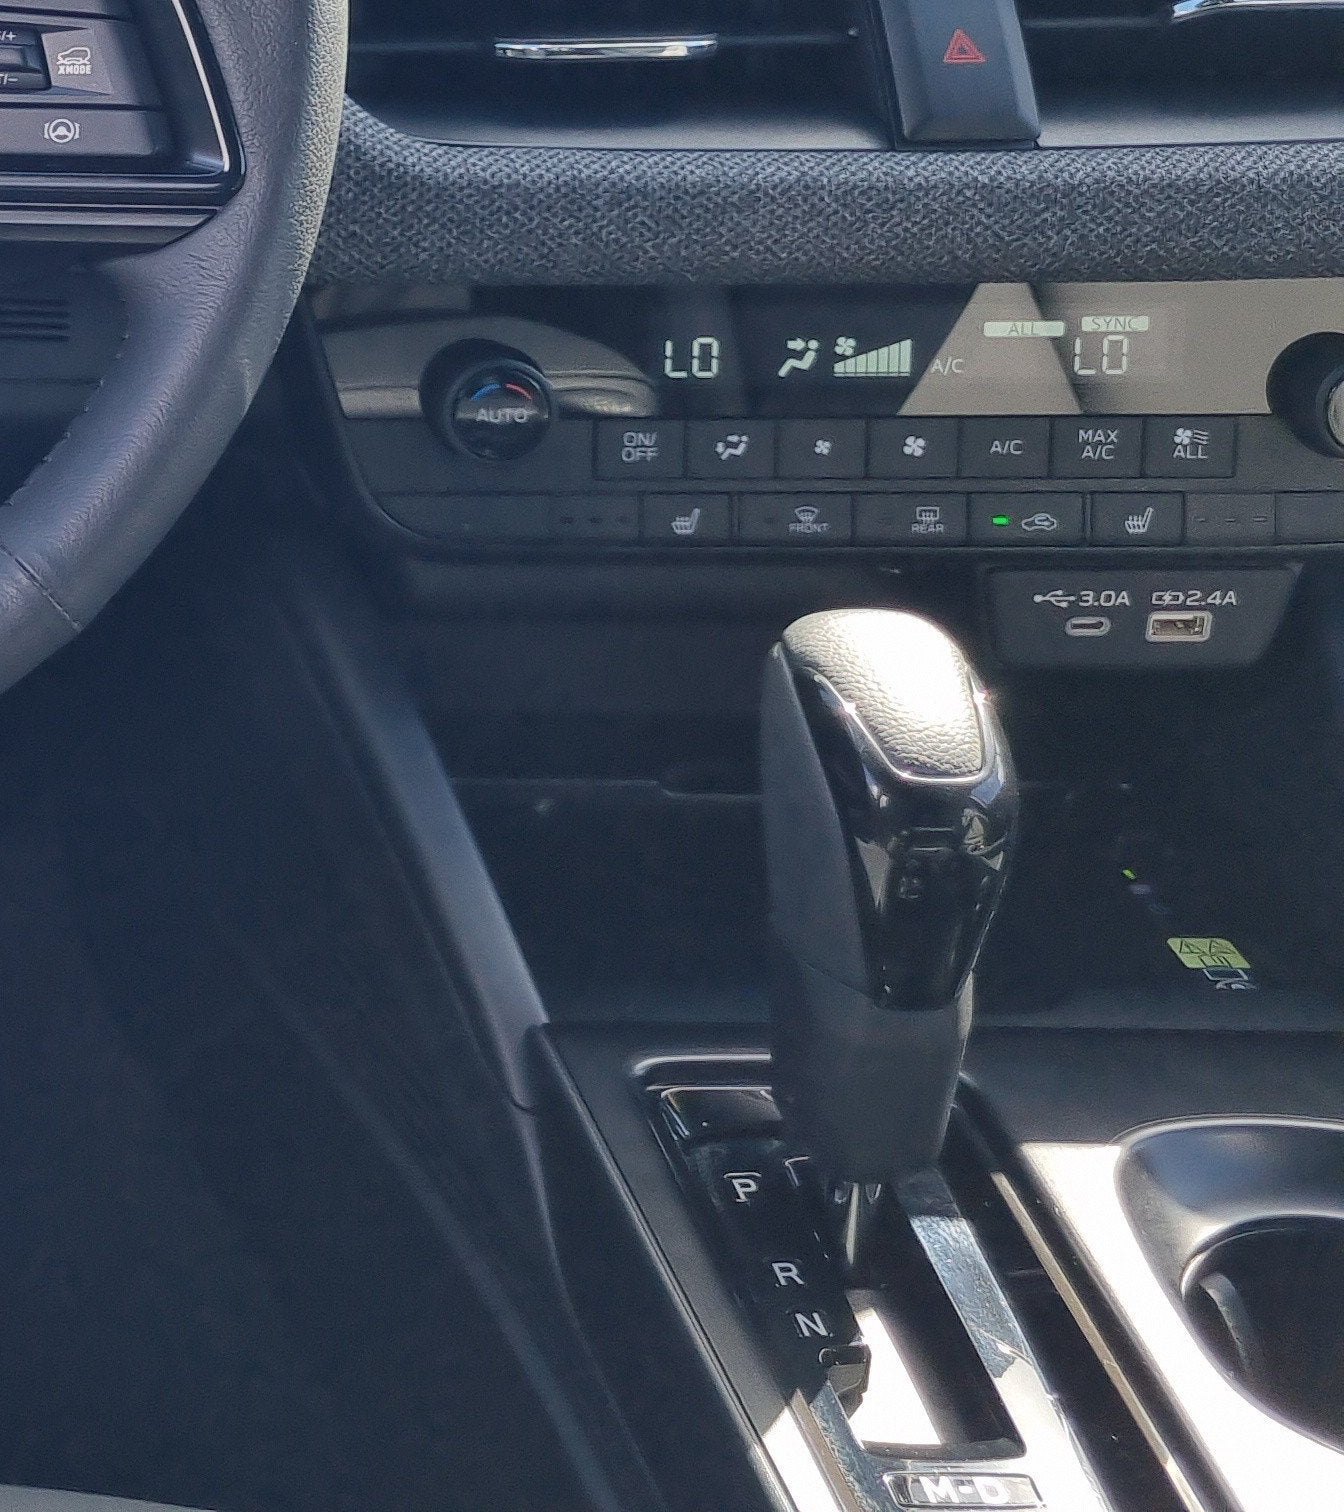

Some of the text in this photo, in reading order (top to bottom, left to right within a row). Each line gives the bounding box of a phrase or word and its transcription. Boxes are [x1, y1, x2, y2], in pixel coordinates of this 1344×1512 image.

[1091, 317, 1140, 331] SYNC
[931, 356, 964, 375] A/C
[475, 408, 529, 423] AUTO
[622, 431, 658, 446] ON/
[1078, 429, 1118, 443] MAX
[621, 447, 659, 463] OFF
[989, 440, 1023, 455] A/C
[1081, 445, 1115, 460] A/C
[1173, 445, 1209, 459] ALL
[788, 523, 830, 533] FRONT
[912, 523, 944, 534] REAR
[1078, 591, 1131, 607] 3.0A
[1185, 590, 1238, 607] 2.4A
[732, 1178, 759, 1203] P
[772, 1262, 805, 1286] R
[794, 1312, 829, 1338] N
